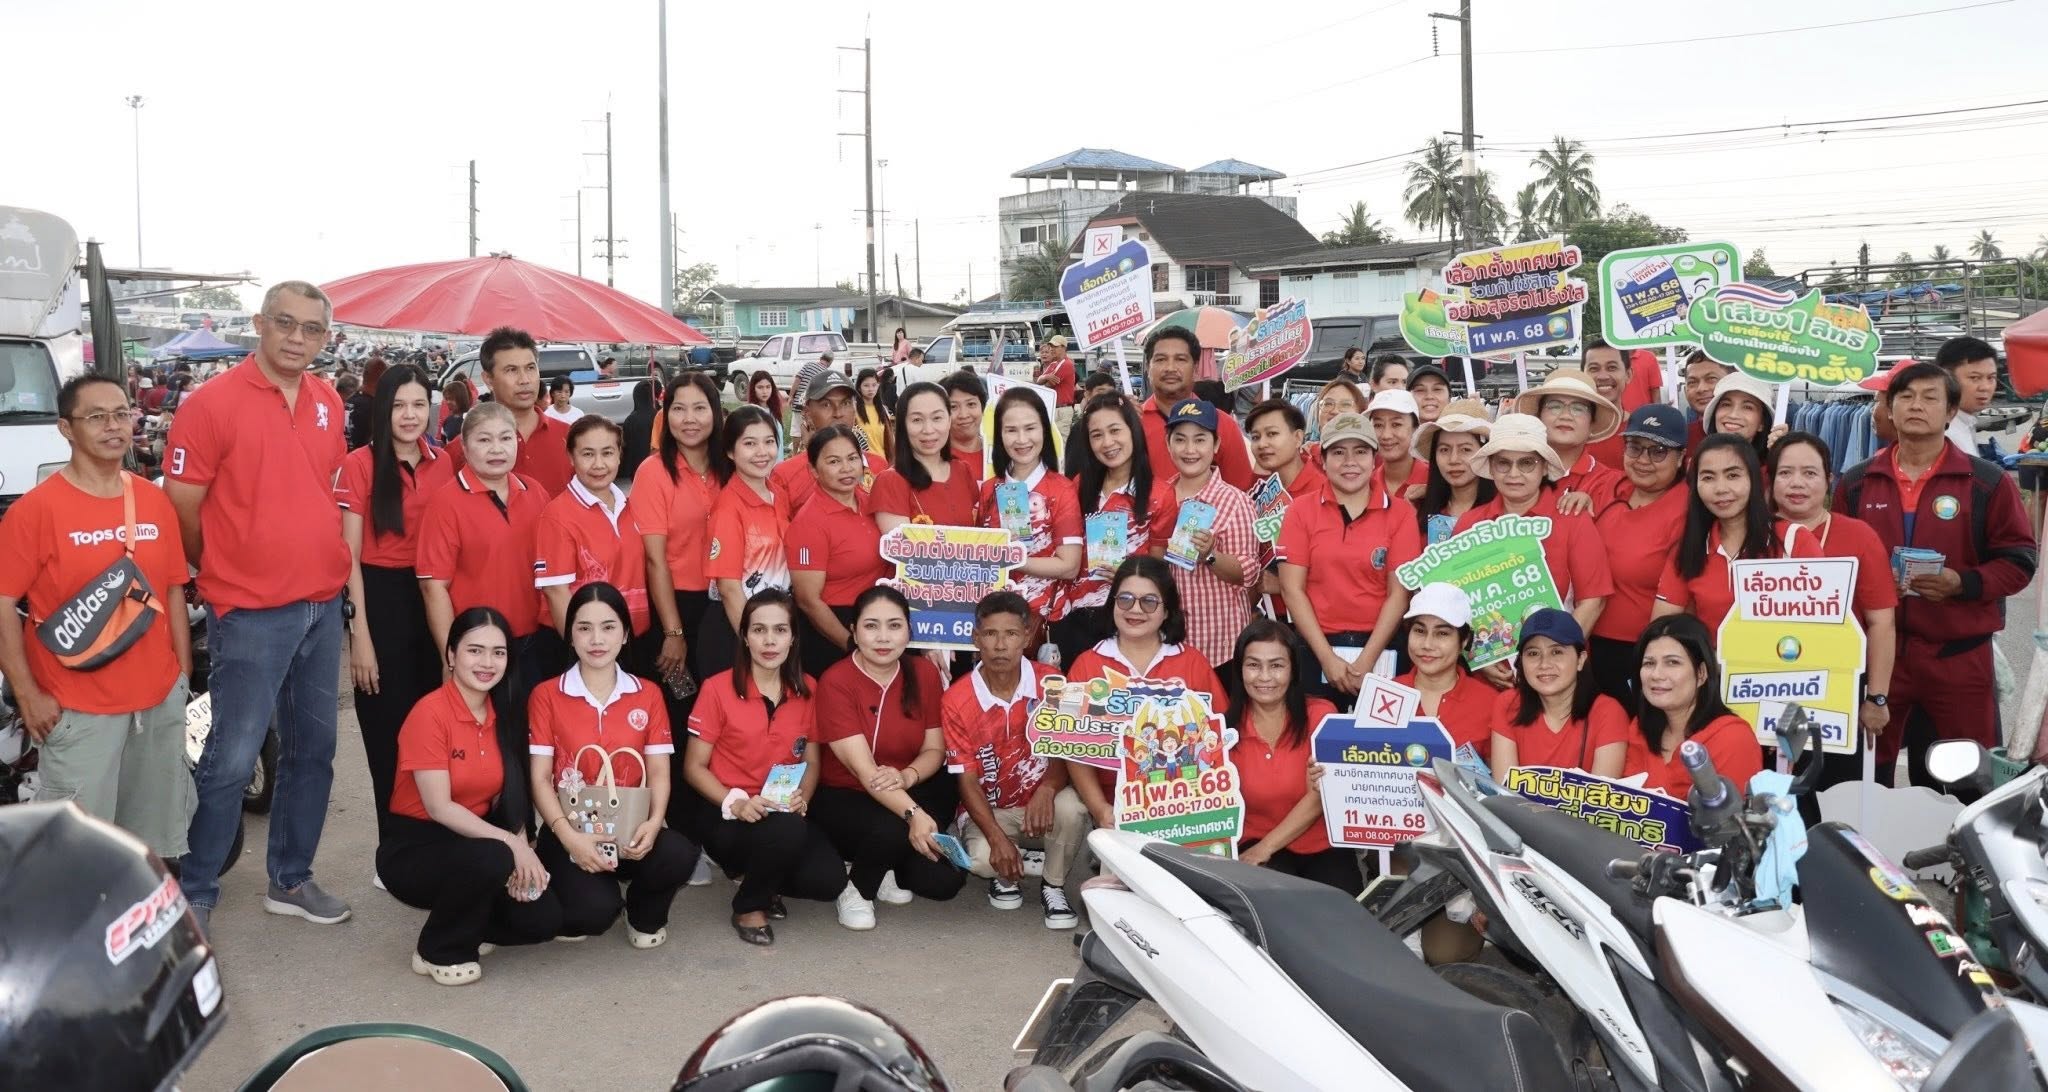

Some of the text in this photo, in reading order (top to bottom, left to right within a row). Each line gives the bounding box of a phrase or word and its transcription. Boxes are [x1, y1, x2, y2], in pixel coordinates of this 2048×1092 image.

[1080, 267, 1118, 292] เลือกตั้ง
[1446, 250, 1578, 284] เลือกตั้งเทศบาล
[1661, 279, 1680, 292] 68
[1088, 320, 1098, 332] 11
[1125, 302, 1140, 315] 68
[1472, 323, 1544, 347] 11 พ.ค. 68
[1744, 353, 1863, 382] เลือกตั้ง
[171, 447, 186, 475] 9
[69, 528, 114, 546] Tops
[883, 530, 1023, 563] เลือกตั้งเทศบาล
[1402, 517, 1548, 587] รักประชาธิปไตย
[1512, 564, 1542, 588] 68
[1743, 565, 1823, 593] เลือกตั้ง
[1752, 589, 1840, 617] เป็นหน้าที่
[54, 587, 109, 650] adidas
[917, 620, 974, 637] พ.ค. 68
[1732, 675, 1820, 699] เลือกคนดี
[1342, 743, 1402, 765] เลือกตั้ง
[1334, 768, 1414, 781] สมาชิกสภาเทศบาล
[1351, 781, 1417, 794] นายกเทศมนตรี
[1122, 770, 1232, 807] 11 พ.ค. 68
[1509, 769, 1649, 815] หนึ่งเสียง
[1121, 811, 1145, 822] เวลา
[1149, 796, 1222, 818] 08.00-17.00
[1345, 810, 1426, 828] 11 พ.ค. 68
[1346, 831, 1363, 839] เวลา
[1113, 916, 1159, 959] PCX
